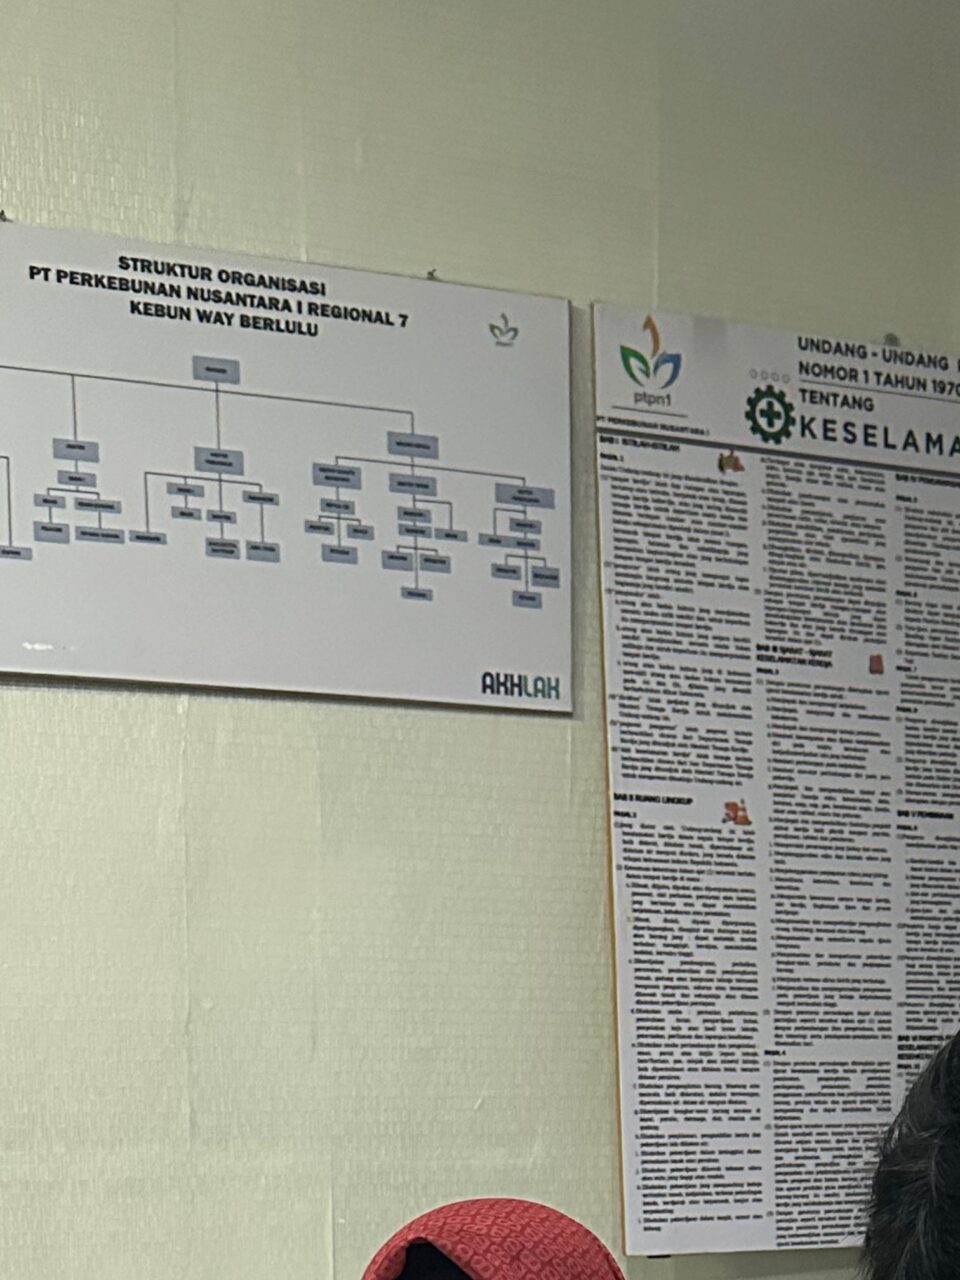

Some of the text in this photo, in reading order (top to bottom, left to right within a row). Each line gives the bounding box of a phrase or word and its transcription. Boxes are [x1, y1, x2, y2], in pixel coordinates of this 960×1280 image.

[118, 255, 327, 297] STRUKTUR ORGANISASI
[28, 265, 409, 328] PT PERKEBUNAN NUSANTARA I REGIONAL 7
[129, 300, 319, 338] KEBUN WAY BERLULU
[797, 336, 868, 360] UNDANG
[882, 347, 950, 371] UNDANG
[798, 361, 859, 383] NOMOR
[862, 369, 869, 384] 1
[873, 371, 927, 392] TAHUN
[633, 391, 672, 407] ptpn1
[798, 388, 875, 412] TENTANG
[481, 671, 560, 700] AKHLAK
